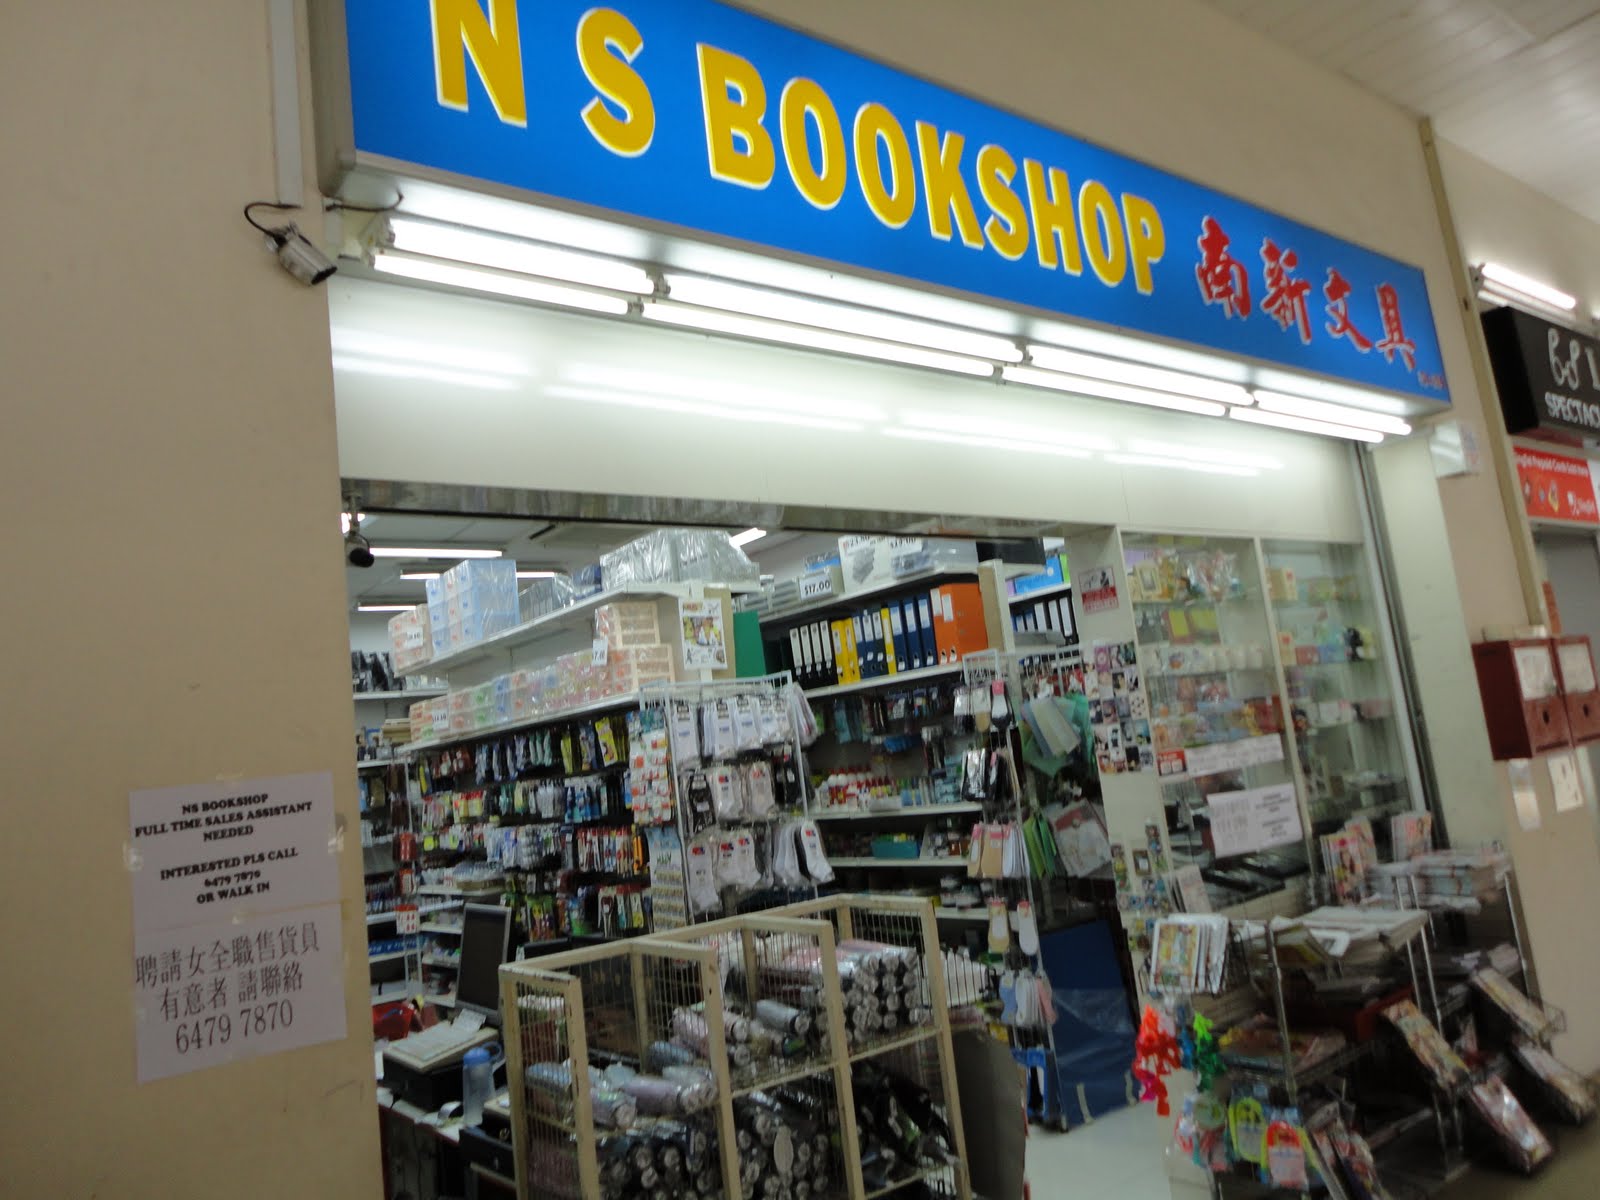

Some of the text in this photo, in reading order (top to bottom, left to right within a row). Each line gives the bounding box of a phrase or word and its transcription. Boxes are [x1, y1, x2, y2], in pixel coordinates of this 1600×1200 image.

[430, 0, 1165, 296] N S BOOKSHOP
[1195, 215, 1416, 372] 南新文具
[804, 580, 830, 595] $17.00
[134, 801, 314, 838] FULL TIME SALES ASSISTANT
[181, 793, 269, 815] NS BOOKSHOP
[203, 825, 254, 842] NEEDED
[160, 847, 299, 881] INTERESTED PLS CALL
[203, 875, 232, 888] 6479
[196, 881, 270, 905] OR WALK IN
[135, 921, 320, 989] 聘請女全職售貨員
[237, 961, 303, 1003] 請聯絡
[175, 998, 293, 1055] 6479 7870
